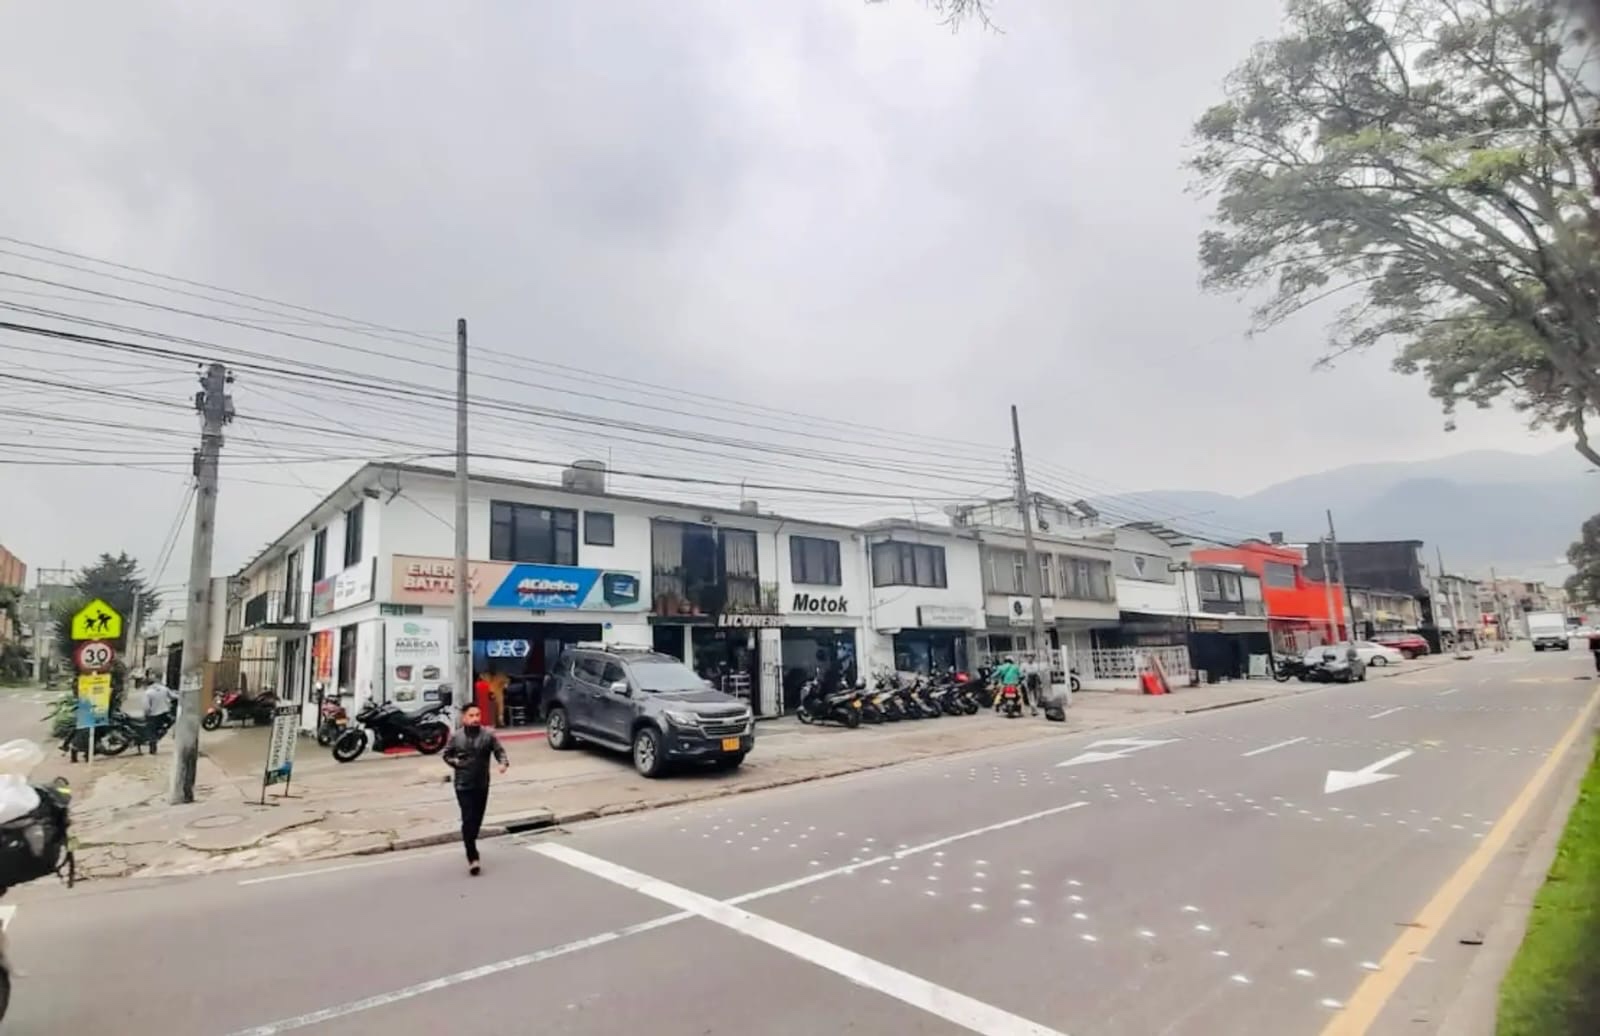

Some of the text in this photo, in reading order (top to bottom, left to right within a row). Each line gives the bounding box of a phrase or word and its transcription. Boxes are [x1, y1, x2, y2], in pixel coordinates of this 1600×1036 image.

[407, 562, 478, 580] ENERY
[403, 577, 481, 594] BATTEY
[792, 592, 849, 613] Motok
[85, 648, 108, 664] 30
